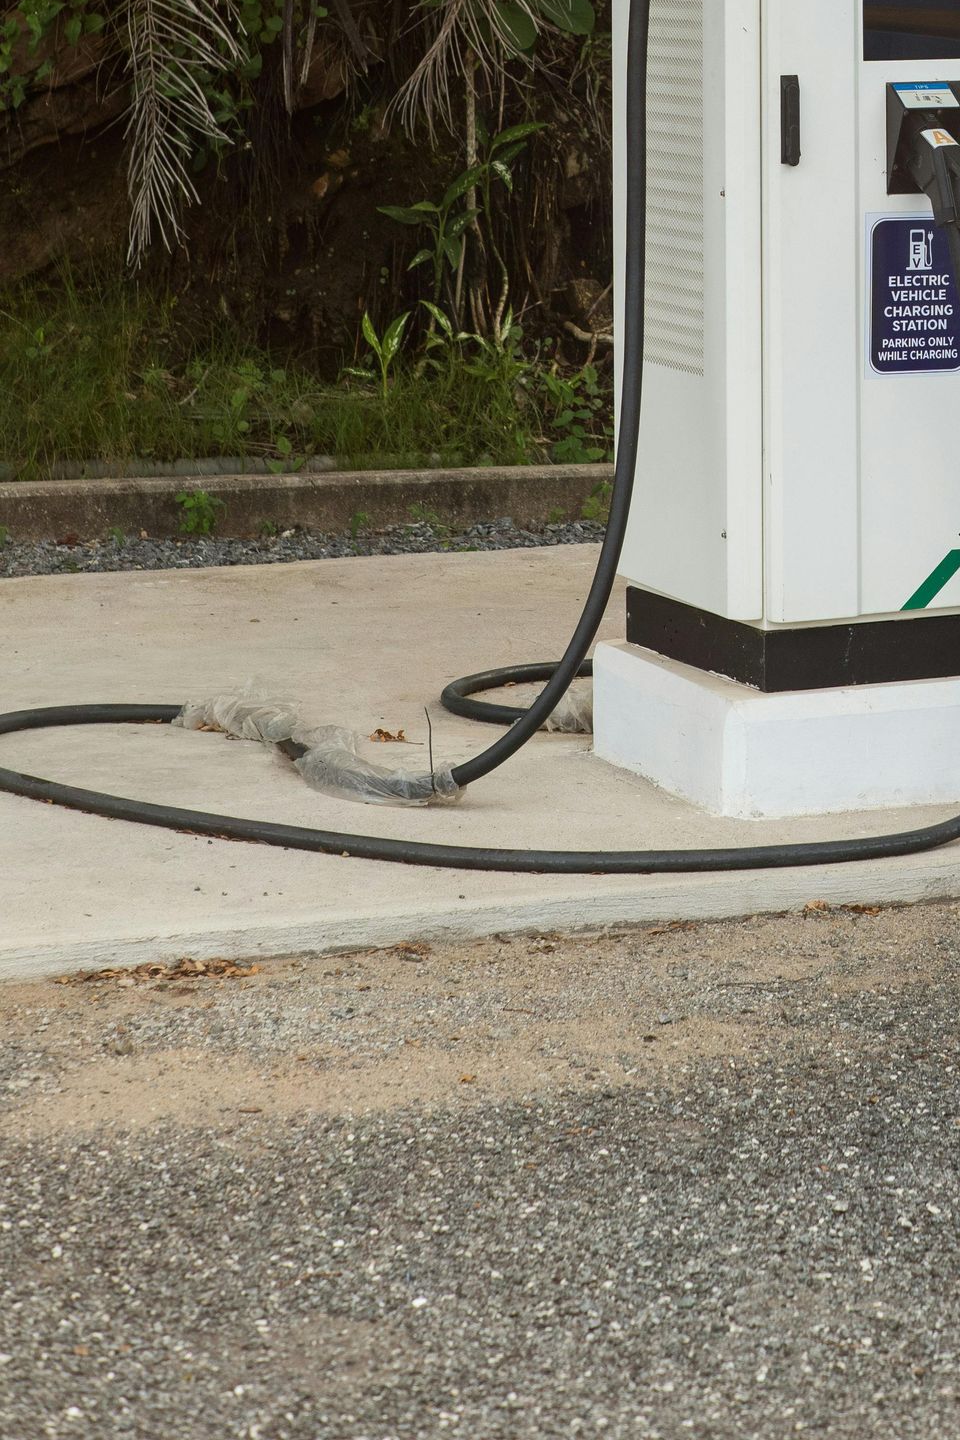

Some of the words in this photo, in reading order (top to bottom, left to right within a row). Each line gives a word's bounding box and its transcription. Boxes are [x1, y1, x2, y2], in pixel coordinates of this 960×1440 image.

[932, 130, 955, 144] A
[888, 274, 950, 287] ELECTRIC
[891, 289, 947, 302] VEHICLE
[884, 304, 954, 318] CHARGING
[892, 319, 947, 332] STATION
[882, 337, 926, 348] PARKING
[928, 336, 955, 346] ONLY
[878, 350, 908, 362] WHILE
[910, 349, 958, 360] CHARGING
